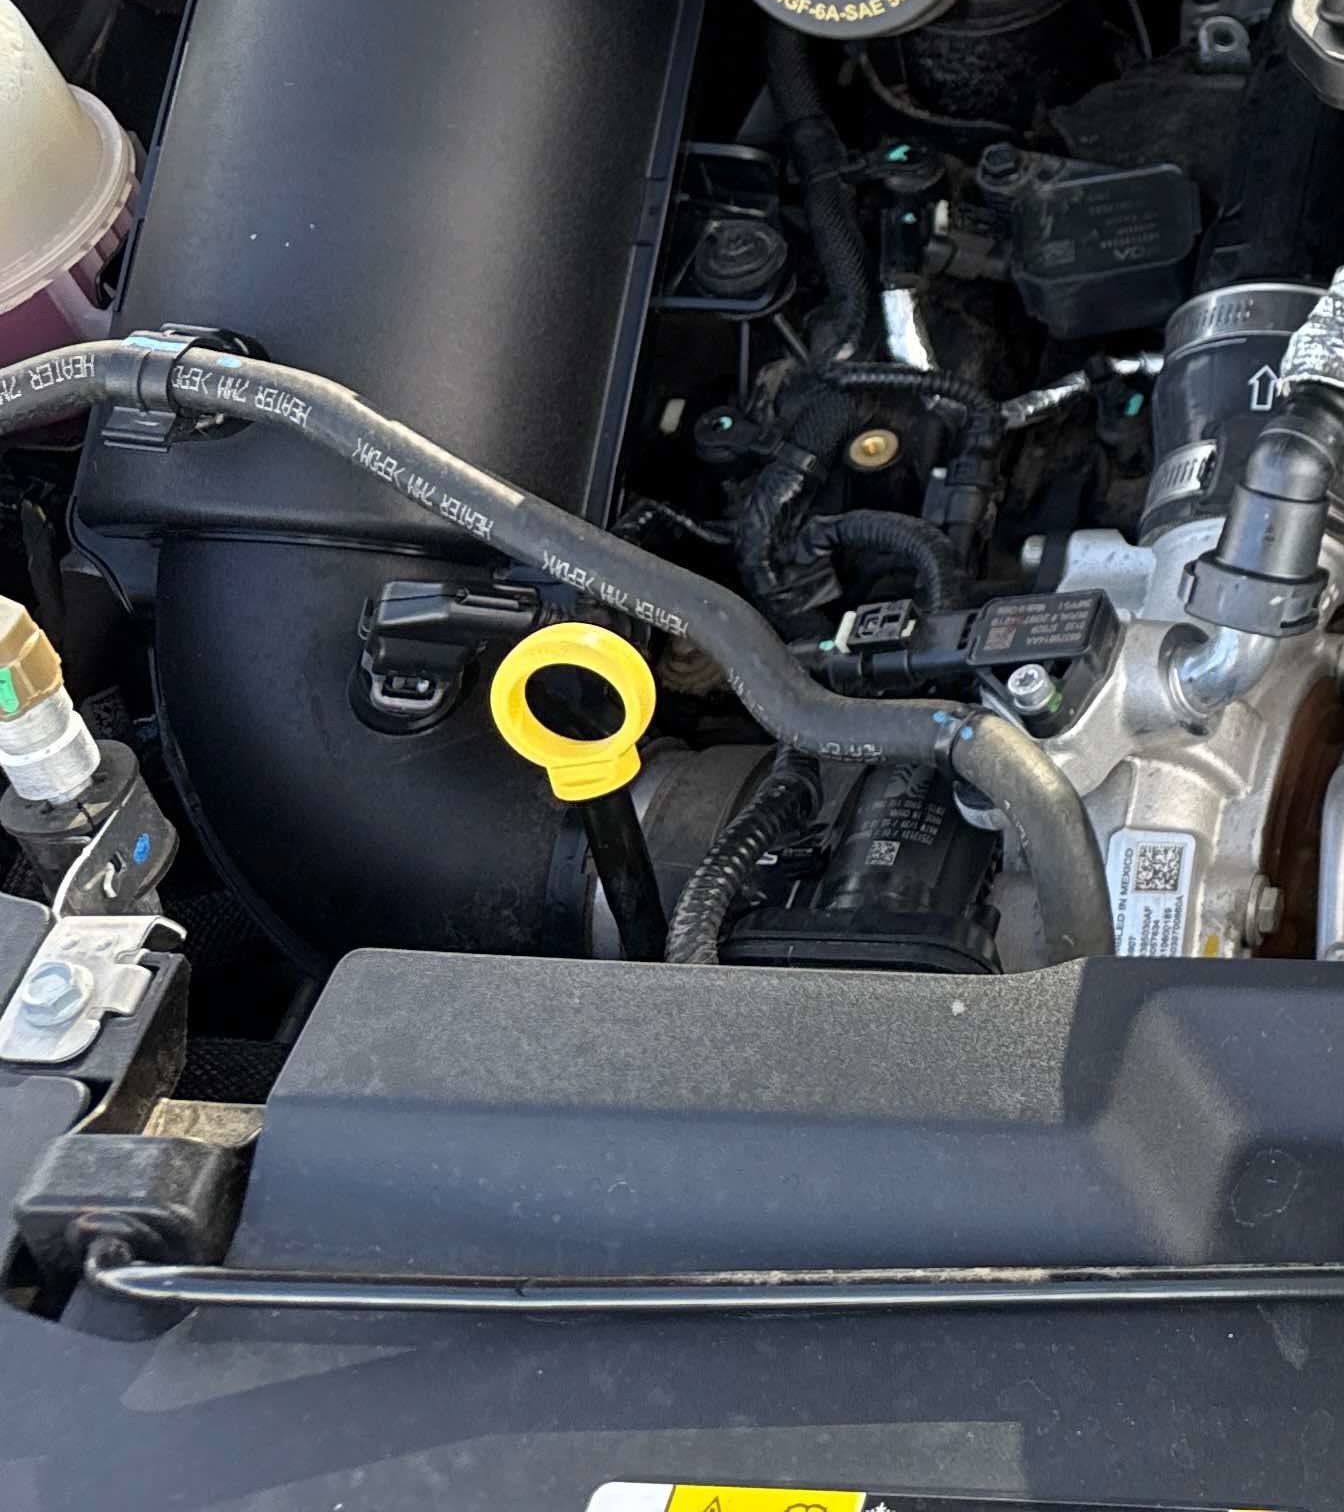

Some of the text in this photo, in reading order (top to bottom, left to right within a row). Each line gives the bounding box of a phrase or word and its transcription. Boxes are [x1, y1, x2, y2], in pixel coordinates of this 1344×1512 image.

[30, 354, 96, 390] HEATER
[255, 389, 313, 429] HEATER
[440, 494, 494, 541] HEATER
[634, 601, 689, 638] HEATER
[1120, 848, 1134, 896] MEXICO
